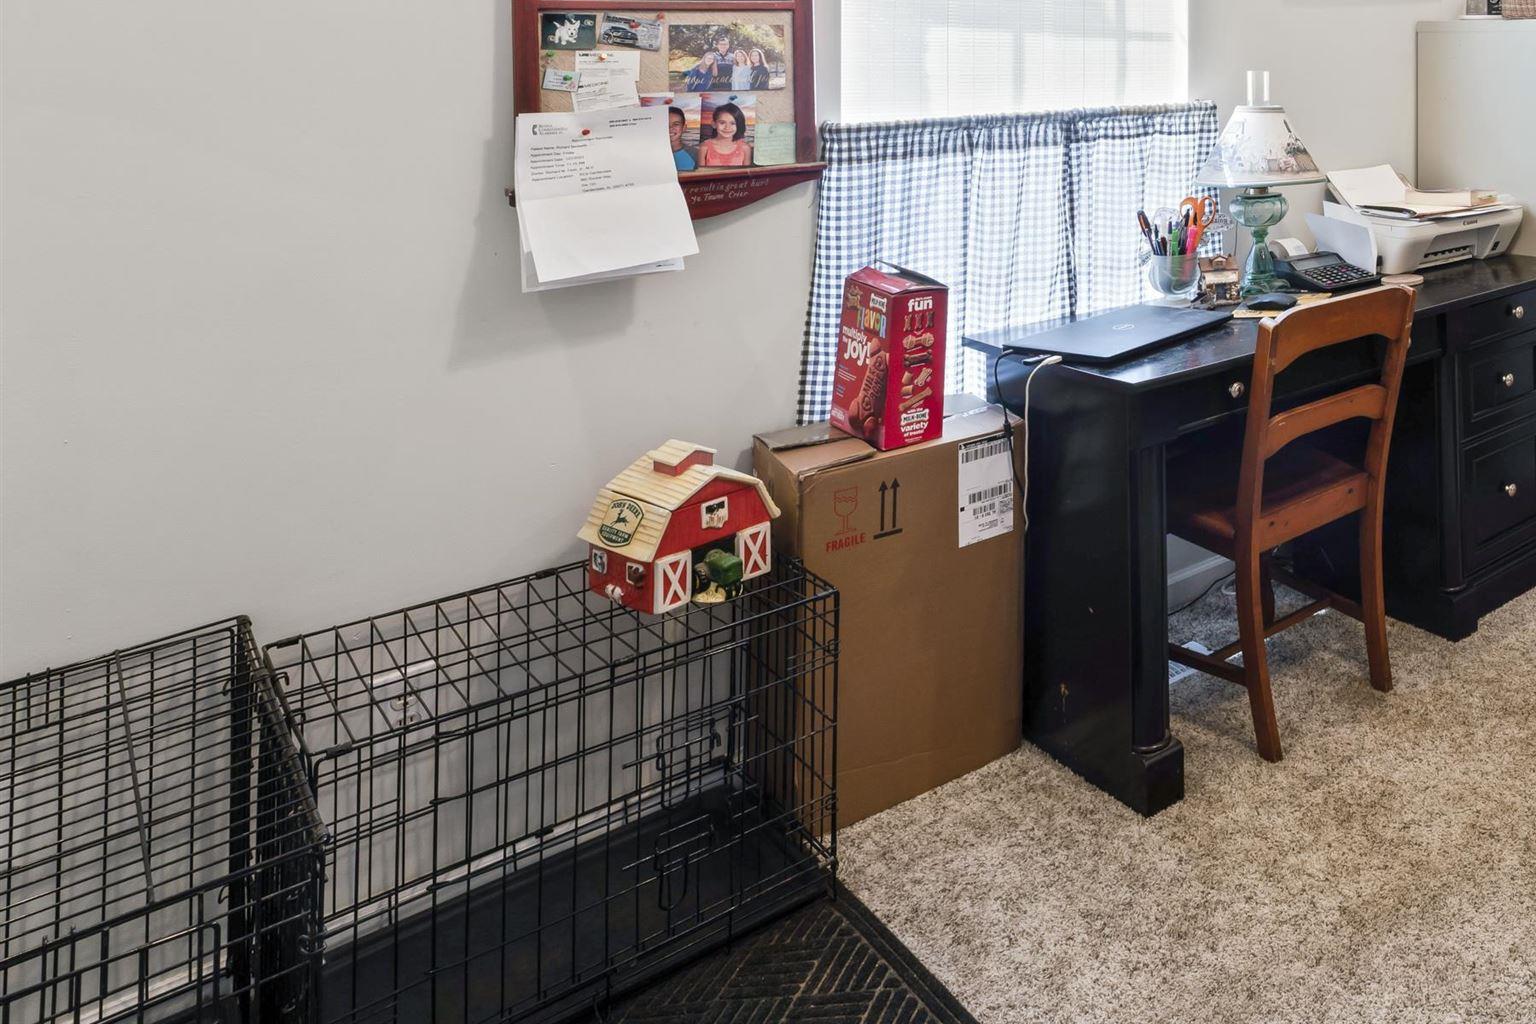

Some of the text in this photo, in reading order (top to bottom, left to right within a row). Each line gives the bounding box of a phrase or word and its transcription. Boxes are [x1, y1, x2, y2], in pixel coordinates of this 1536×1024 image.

[908, 298, 933, 313] fun
[900, 421, 929, 433] variety
[825, 532, 867, 553] FRAGILE
